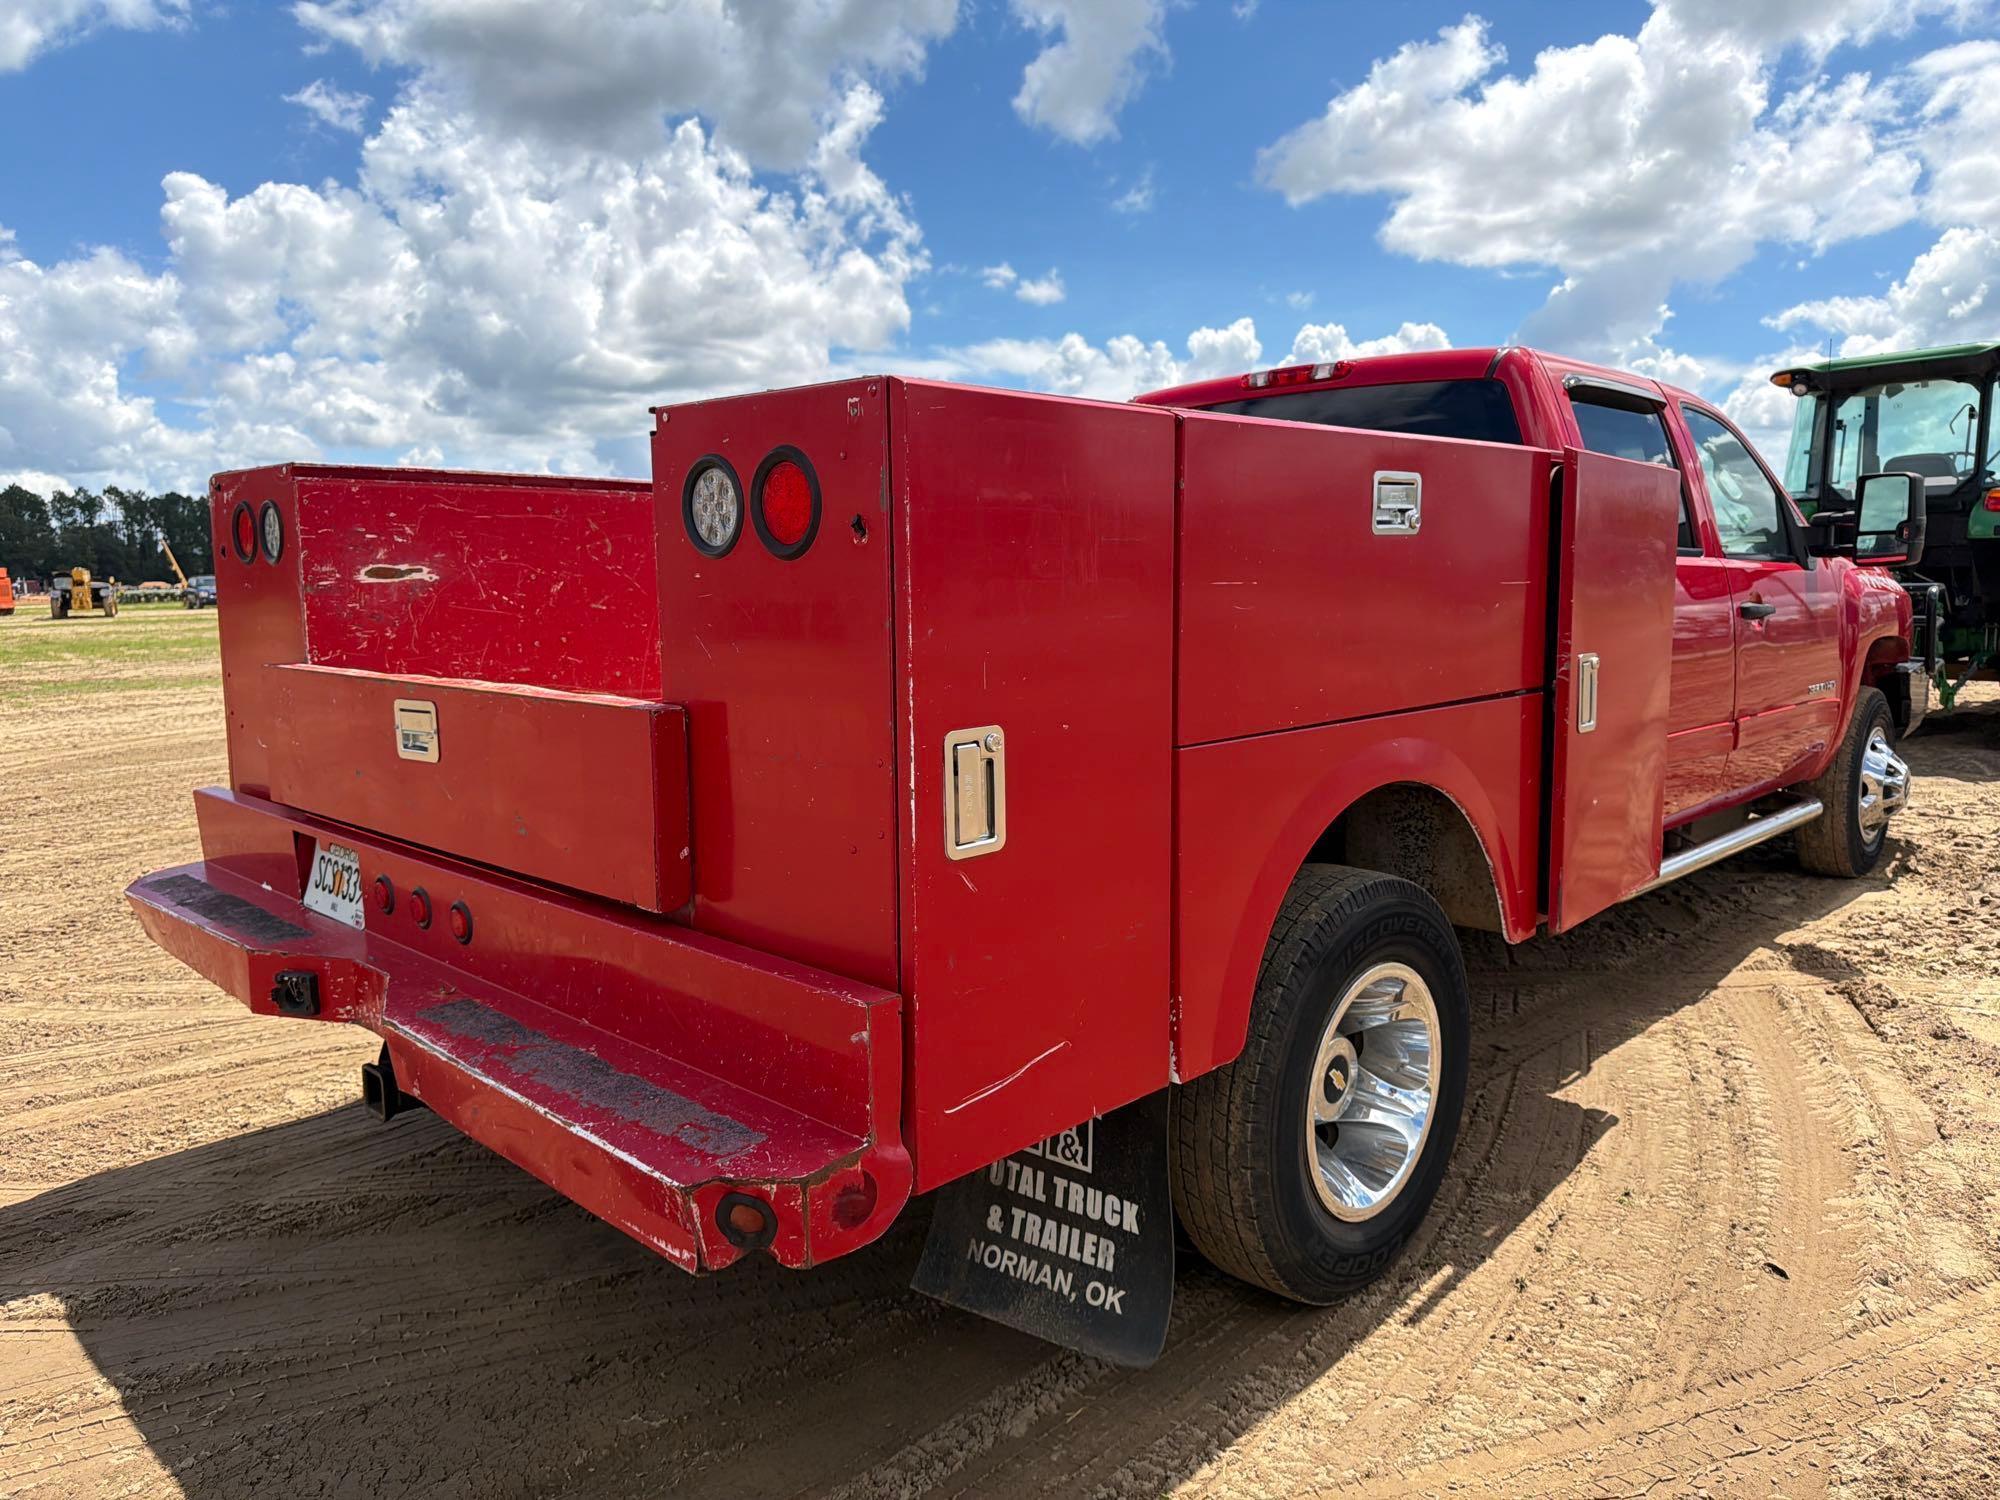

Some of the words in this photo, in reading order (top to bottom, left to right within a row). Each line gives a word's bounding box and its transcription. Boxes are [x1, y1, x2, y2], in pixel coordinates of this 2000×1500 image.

[329, 843, 359, 863] GEORGI
[989, 1158, 1046, 1203] OTAL
[1053, 1175, 1140, 1235] TRUCK
[986, 1204, 1004, 1234] &
[1011, 1206, 1116, 1273] TRAILER
[967, 1238, 1078, 1303] NORMAN,
[1085, 1280, 1127, 1316] OK
